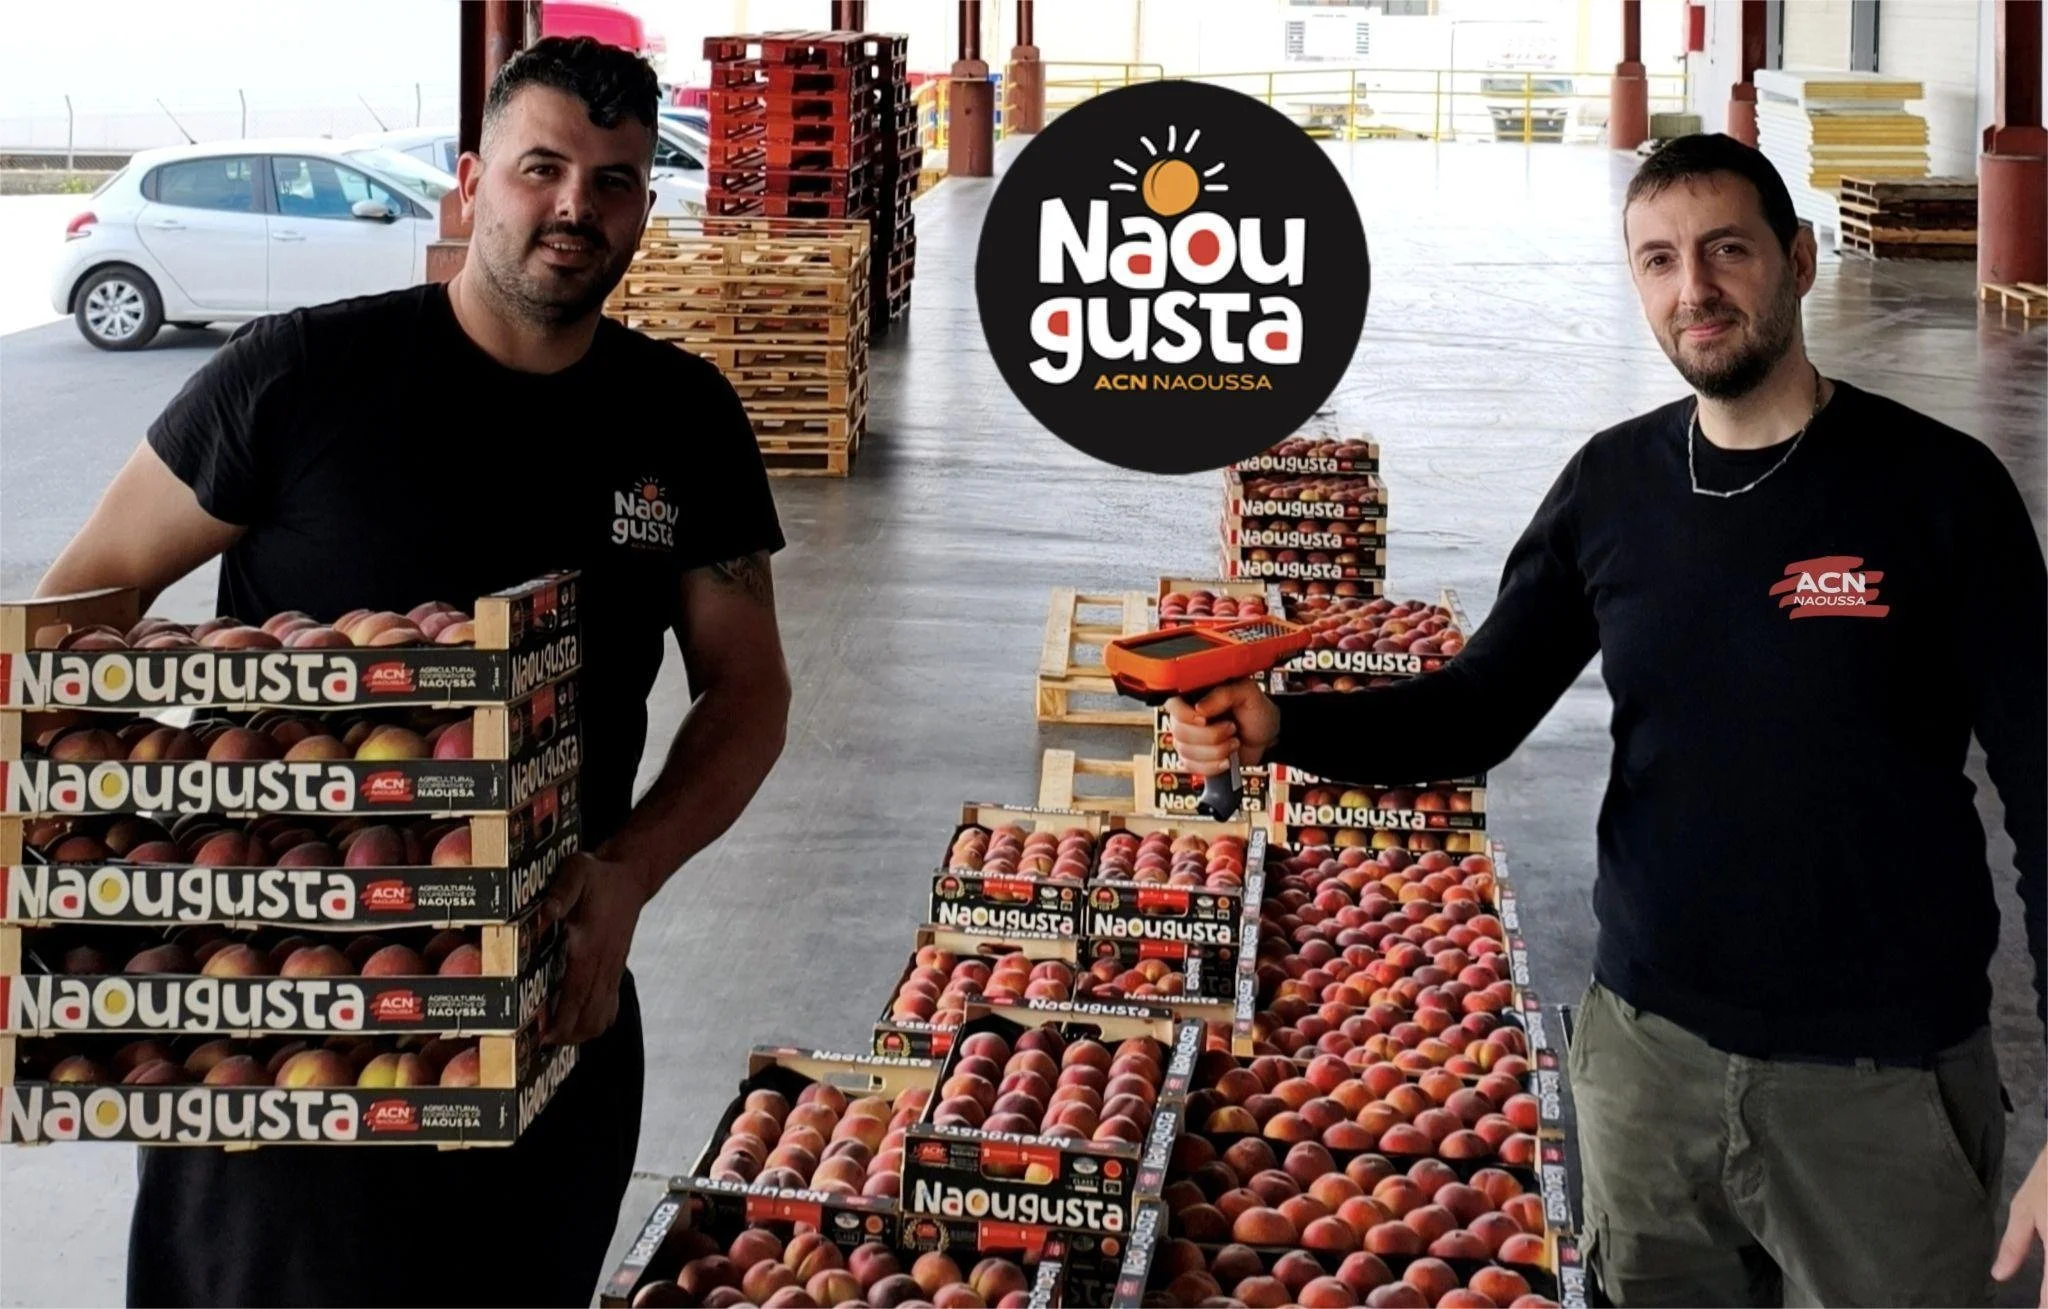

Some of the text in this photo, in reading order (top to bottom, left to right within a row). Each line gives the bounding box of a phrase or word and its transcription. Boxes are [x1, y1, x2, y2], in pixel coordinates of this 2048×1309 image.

[614, 490, 679, 526] Naou
[1240, 499, 1344, 518] Naougusta
[611, 518, 674, 547] gusta
[1238, 529, 1342, 548] Naougusta
[1238, 559, 1342, 579] Naougusta
[1796, 571, 1866, 594] ACN
[1793, 595, 1867, 606] NAOUSSA
[372, 669, 405, 679] ACN
[512, 635, 577, 698] Naougusta
[11, 652, 357, 703] Naougusta
[419, 679, 476, 688] NAOUSSA
[9, 760, 356, 814] Naougusta
[372, 779, 405, 789] ACN
[417, 789, 475, 798] NAOUSSA
[1286, 802, 1426, 830] Naougusta
[7, 866, 356, 921] Naougusta
[372, 888, 405, 898] ACN
[418, 898, 476, 907] NAOUSSA
[938, 901, 1074, 935] Naougusta
[1094, 912, 1232, 944] Naougusta
[9, 976, 364, 1032] Naougusta
[380, 997, 414, 1008] ACN
[427, 1008, 486, 1017] NAOUSSA
[1028, 998, 1150, 1018] Naougusta
[3, 1085, 359, 1142] Naougusta
[376, 1107, 410, 1118] ACN
[422, 1118, 480, 1128] NAOUSSA
[933, 1124, 1072, 1149] Naougusta
[695, 1178, 830, 1203] Naougusta
[914, 1178, 1124, 1232] Naougusta
